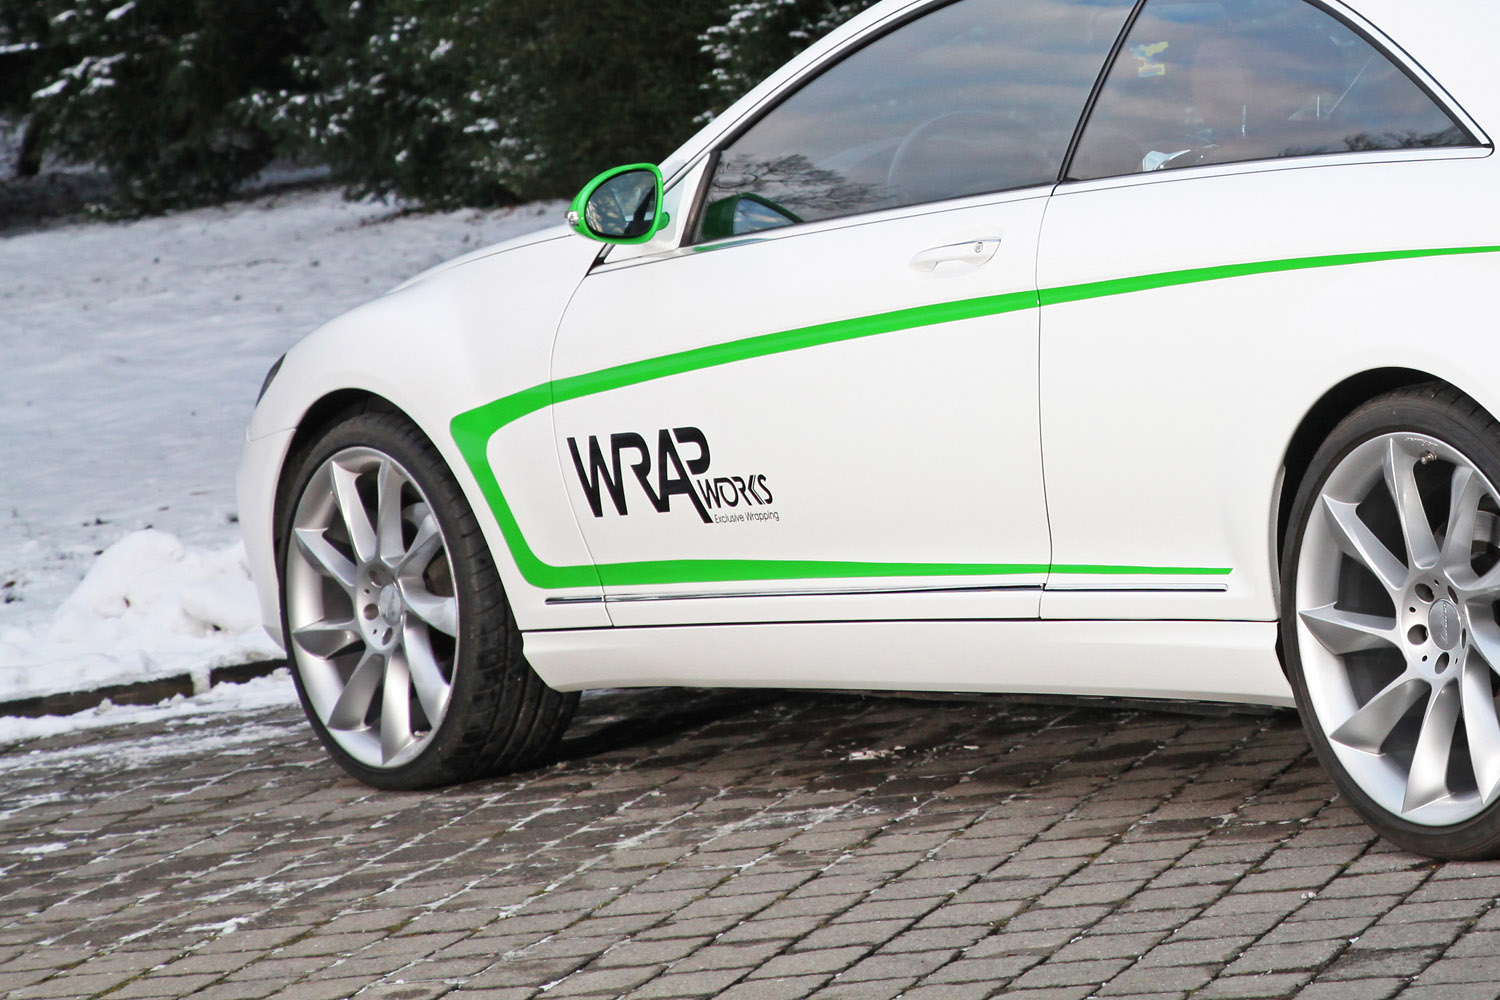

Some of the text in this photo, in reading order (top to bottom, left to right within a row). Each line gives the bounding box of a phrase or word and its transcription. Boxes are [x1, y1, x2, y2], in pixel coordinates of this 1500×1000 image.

[566, 426, 773, 524] WRAP WORKS
[714, 510, 780, 524] Exclusive Wrapping
